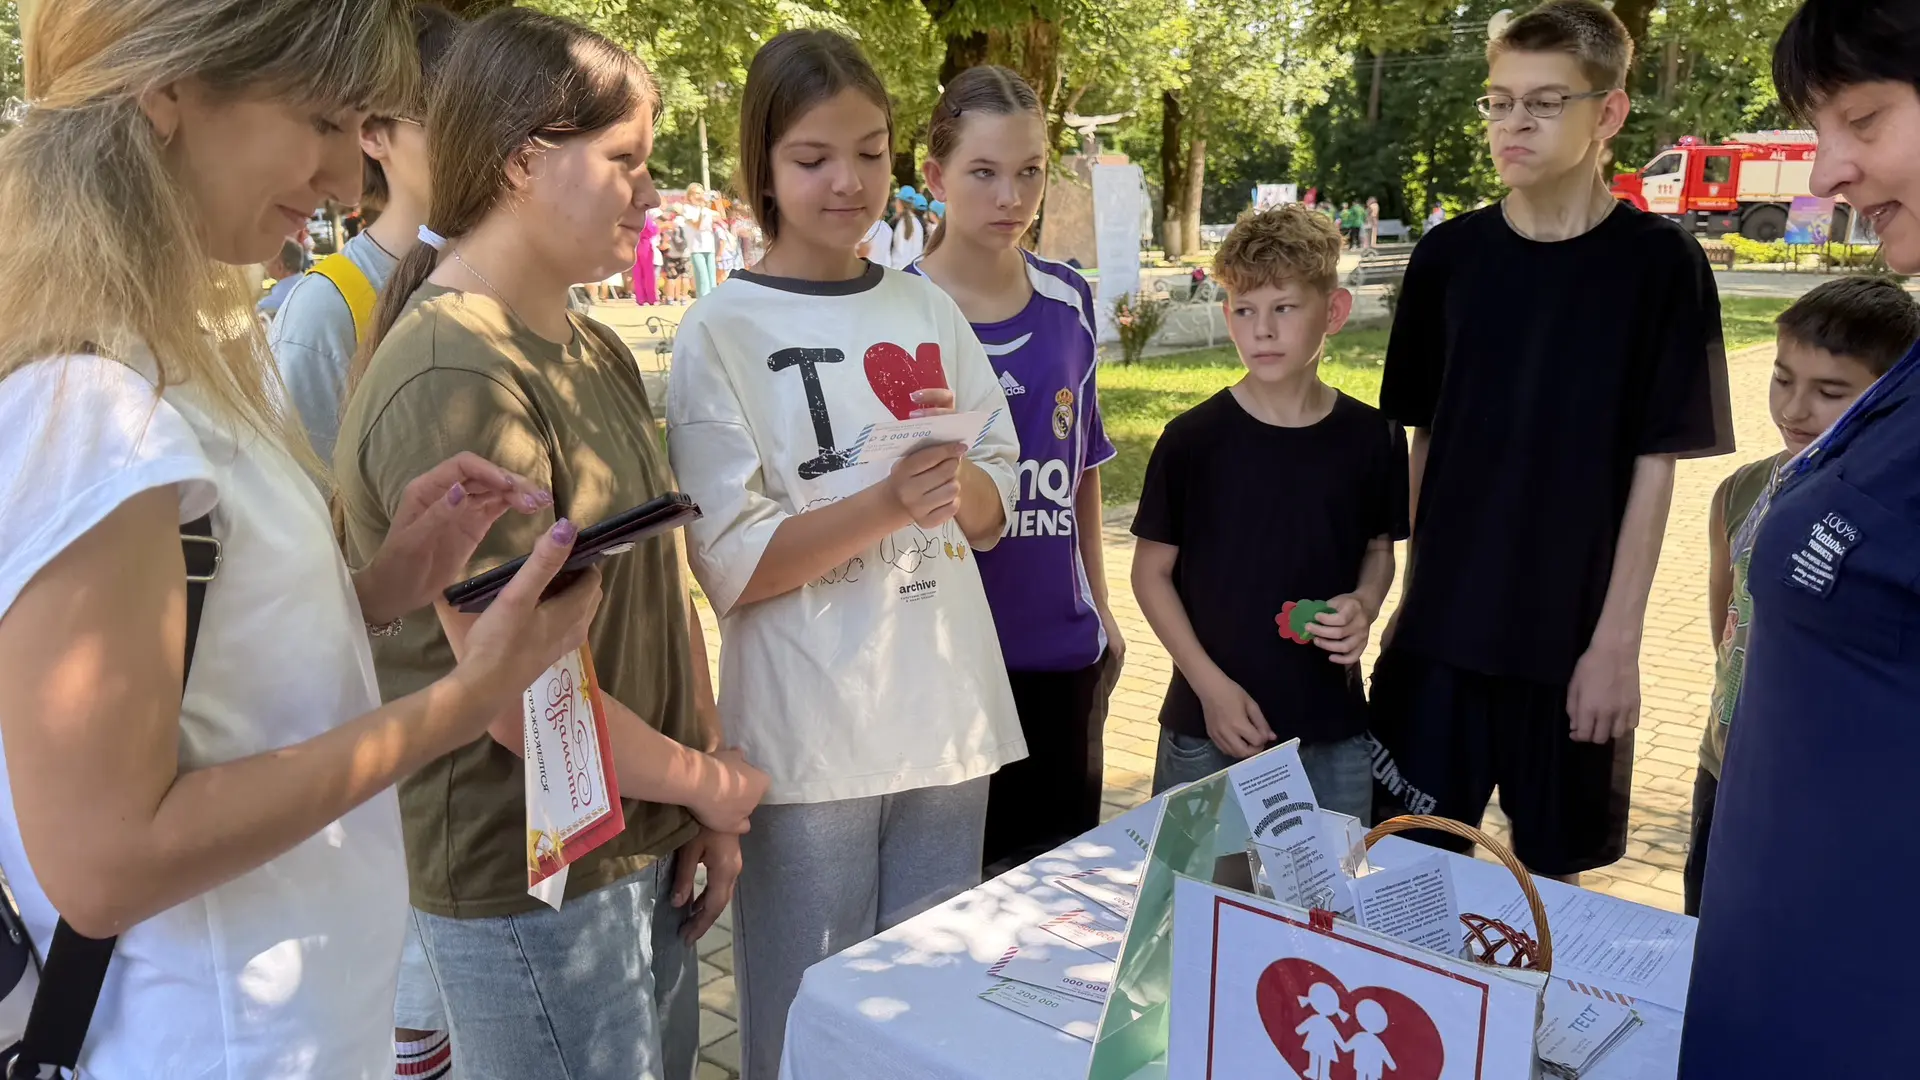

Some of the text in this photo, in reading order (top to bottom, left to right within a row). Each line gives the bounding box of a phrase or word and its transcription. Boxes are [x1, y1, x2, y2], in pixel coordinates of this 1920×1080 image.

[1005, 385, 1026, 397] das
[890, 432, 909, 441] 000
[912, 430, 932, 438] 000
[1015, 458, 1072, 508] nQ
[1001, 509, 1072, 538] MENS
[1822, 512, 1858, 542] 100%
[899, 578, 938, 595] archive
[545, 668, 592, 812] Грамота
[1062, 977, 1084, 987] 000
[1086, 983, 1107, 993] 000
[1016, 989, 1038, 1000] 200
[1039, 997, 1060, 1009] 000
[1568, 1003, 1600, 1033] ТЕСТ
